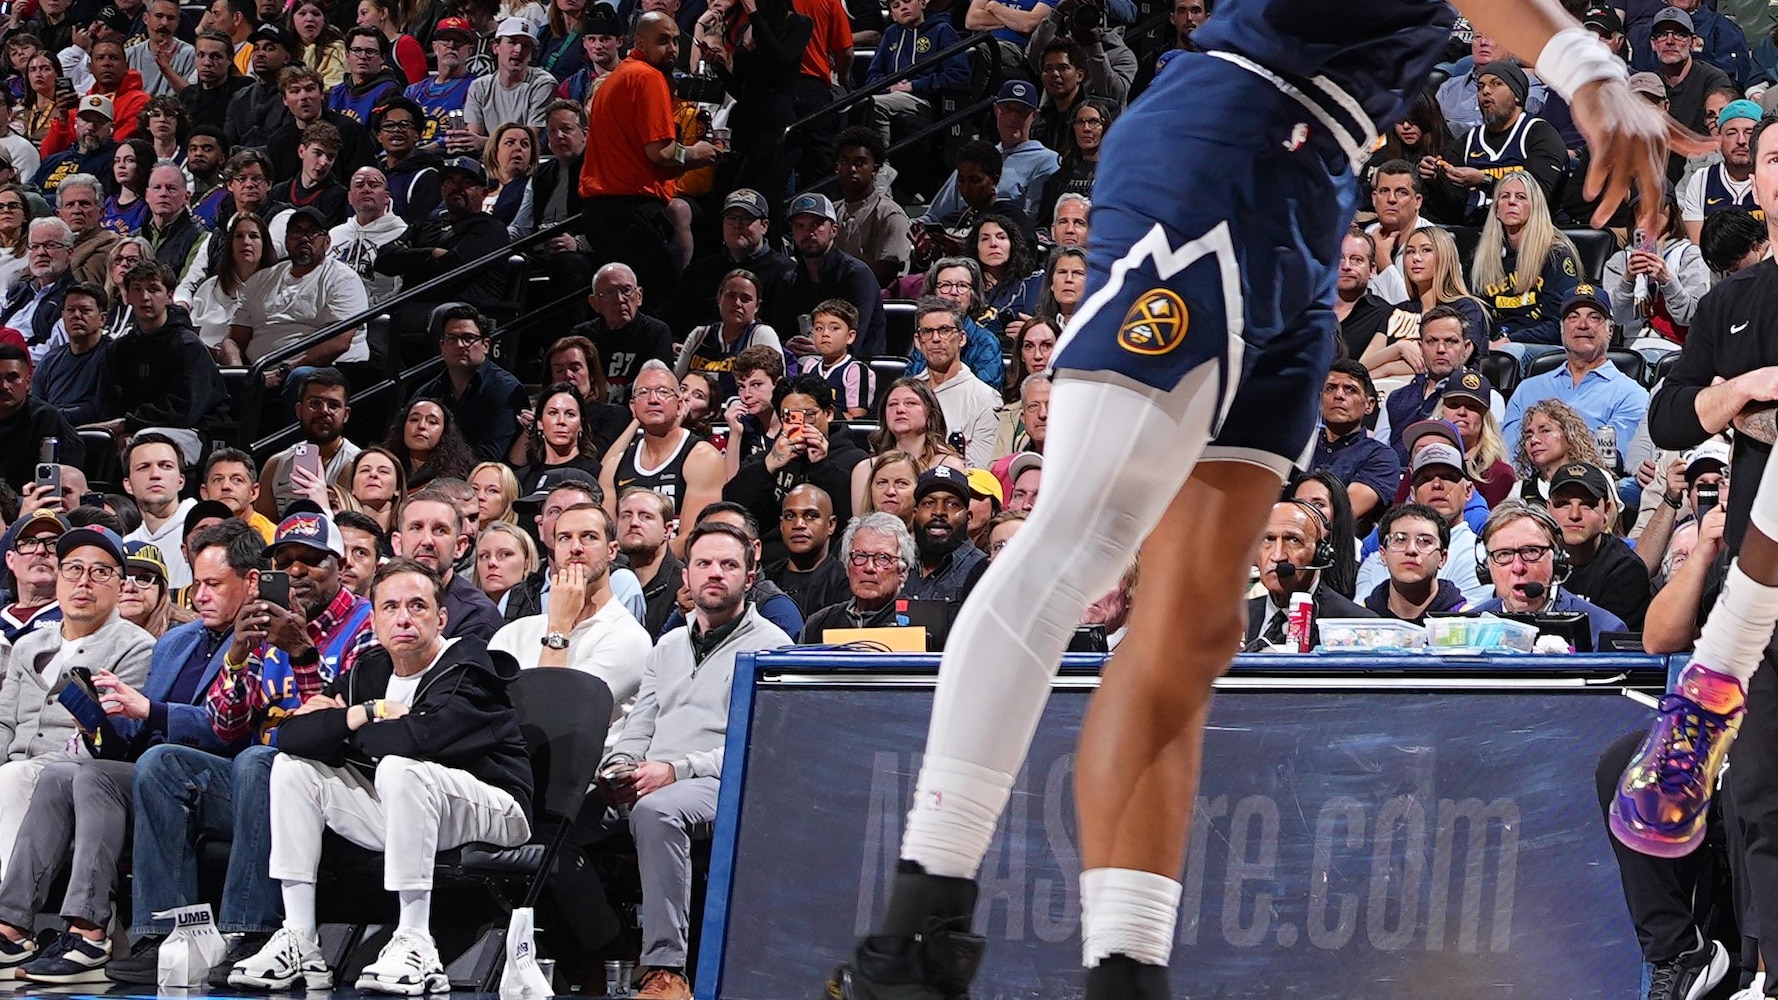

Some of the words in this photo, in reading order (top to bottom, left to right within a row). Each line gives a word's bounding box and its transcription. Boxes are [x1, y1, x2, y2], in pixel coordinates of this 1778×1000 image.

[1487, 272, 1545, 298] DENR
[607, 351, 638, 377] 27
[262, 677, 296, 705] ILE
[177, 910, 212, 925] UMB
